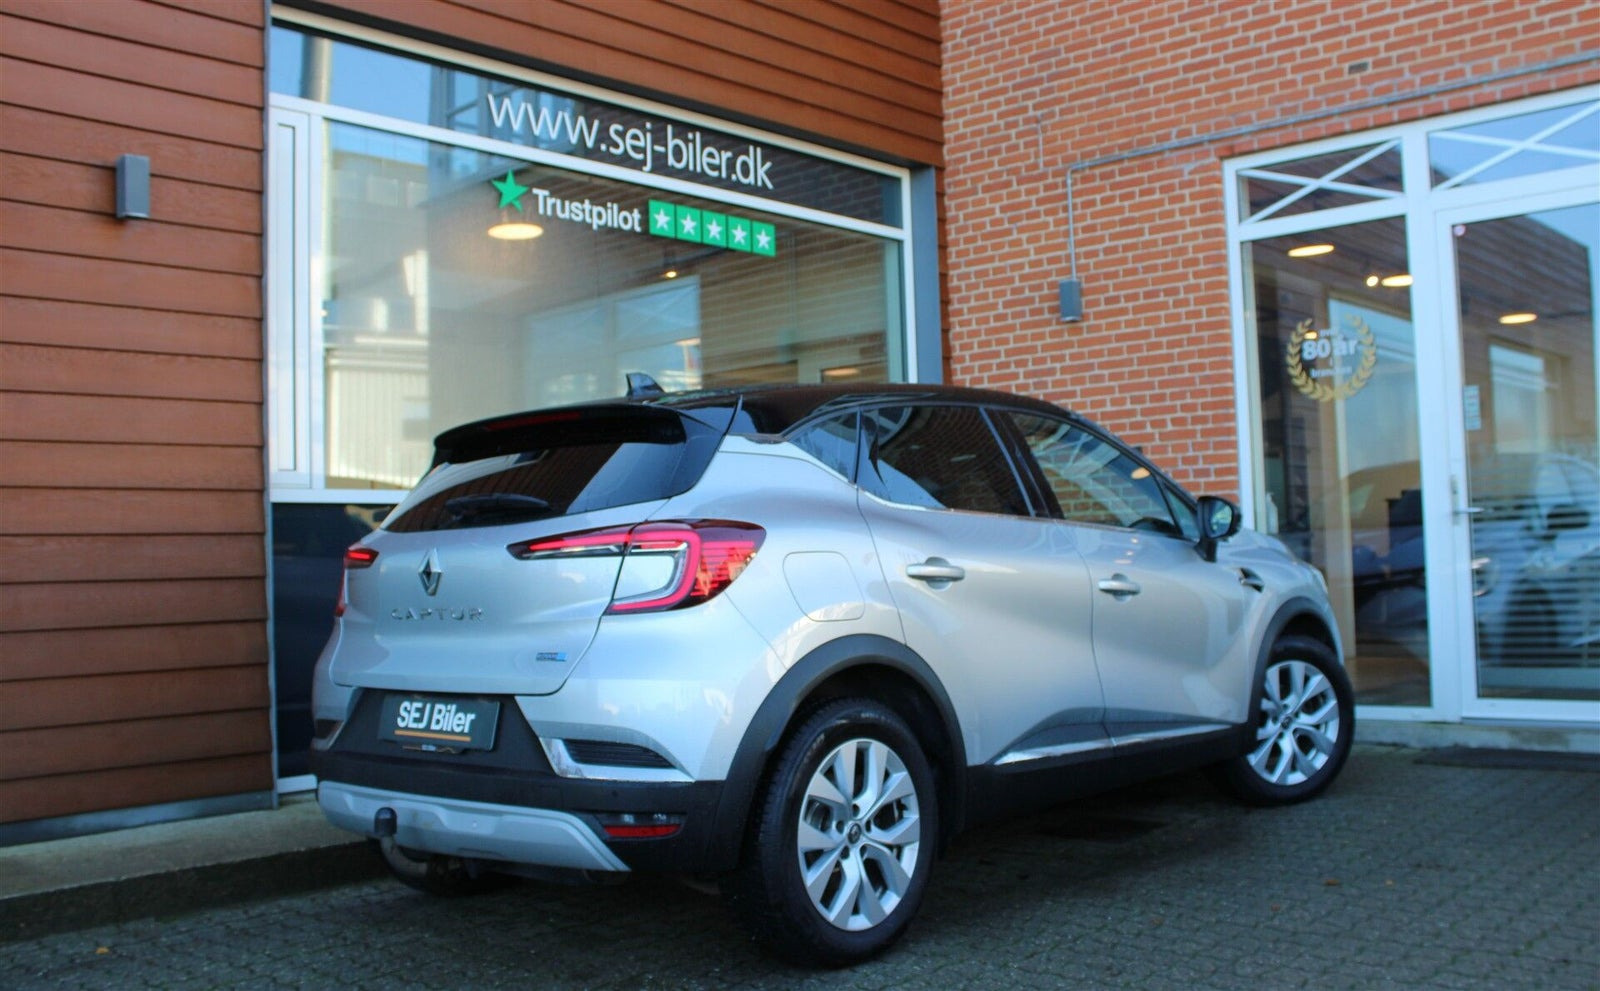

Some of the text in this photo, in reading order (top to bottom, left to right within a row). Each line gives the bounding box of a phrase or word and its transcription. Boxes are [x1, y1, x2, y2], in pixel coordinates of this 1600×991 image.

[487, 93, 774, 190] www.sej-biler.dk
[532, 188, 642, 232] Trustpilot
[1302, 338, 1331, 360] 80
[391, 607, 483, 621] CAPTUR
[397, 701, 476, 733] SEJ Biler
